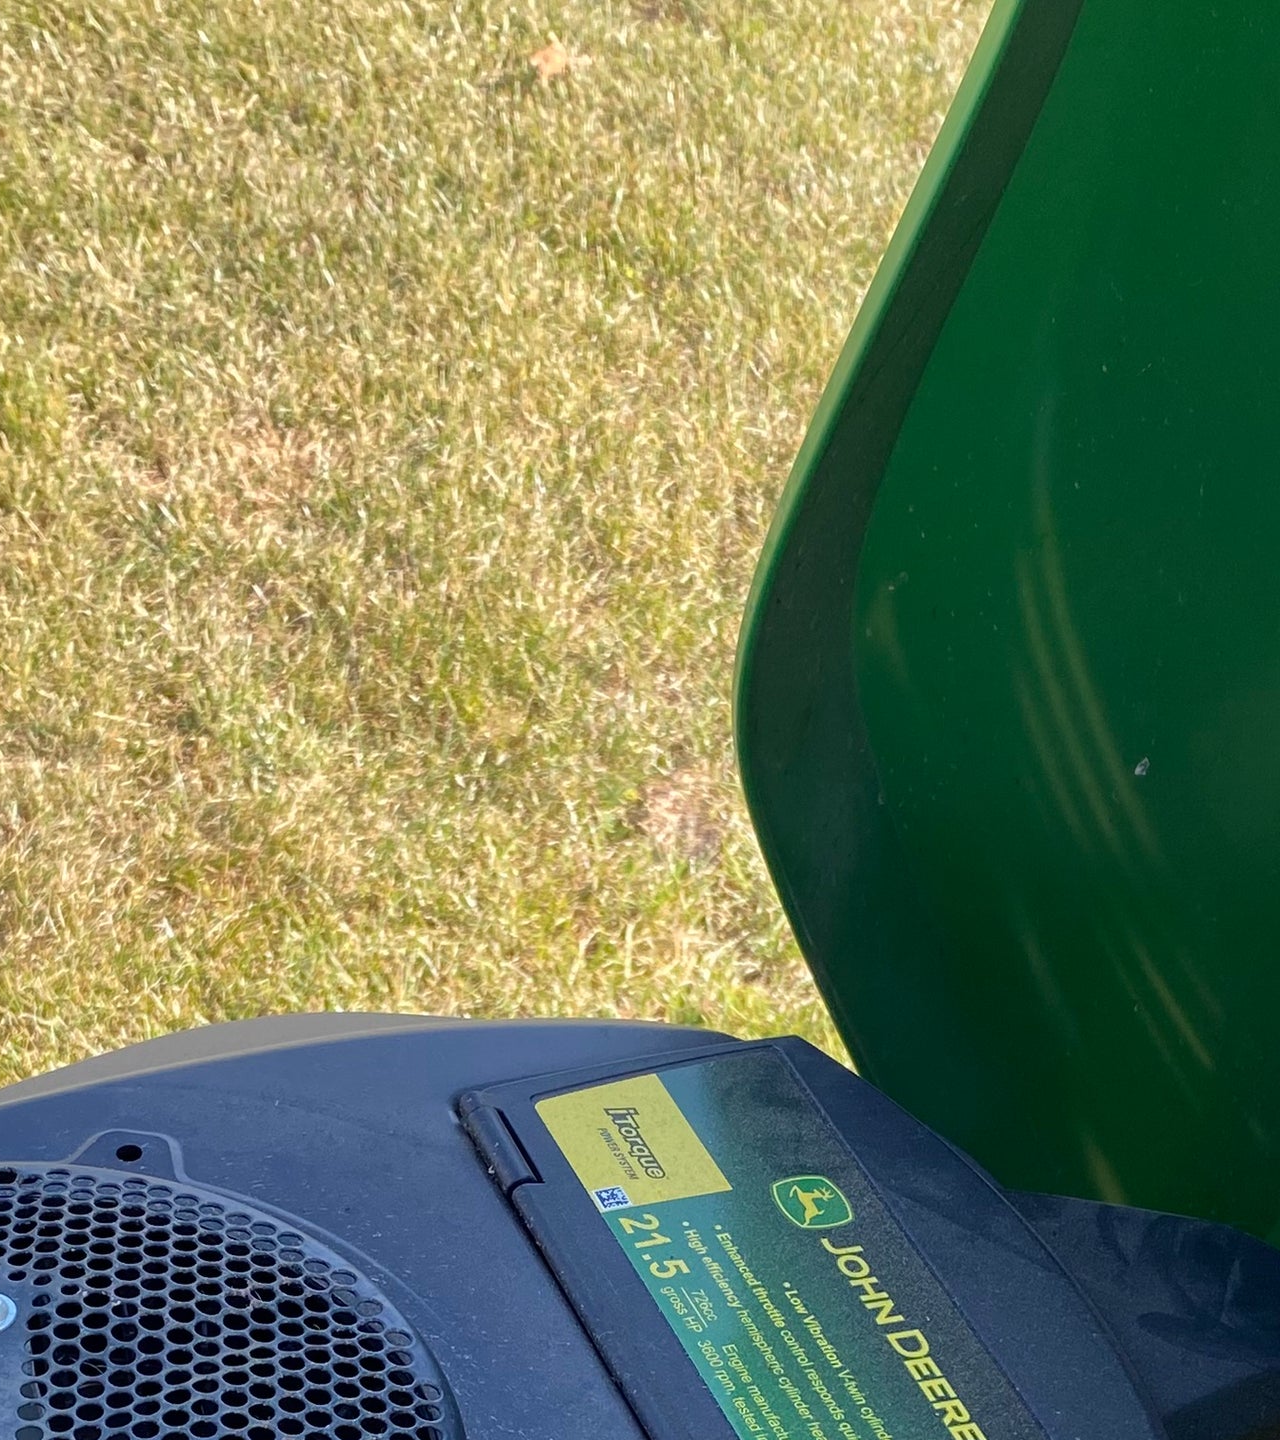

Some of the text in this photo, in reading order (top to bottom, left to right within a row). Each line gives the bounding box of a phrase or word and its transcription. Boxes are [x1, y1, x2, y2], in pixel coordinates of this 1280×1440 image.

[597, 1127, 640, 1180] POWER SYSTEM
[603, 1107, 666, 1179] iTorque
[618, 1213, 691, 1279] 21.5
[821, 1237, 905, 1325] JOHN
[660, 1286, 703, 1334] gross HP
[684, 1228, 708, 1255] High
[702, 1256, 743, 1309] efficiency
[736, 1309, 784, 1376] hemispheric
[778, 1376, 814, 1420] cylinder
[690, 1289, 718, 1322] 726cc
[716, 1232, 761, 1287] Enhanced
[752, 1285, 786, 1329] throttle
[780, 1329, 814, 1368] control
[805, 1368, 845, 1421] responds
[722, 1344, 753, 1384] Engine
[784, 1290, 809, 1315] Low
[803, 1315, 843, 1369] Vibration
[838, 1369, 866, 1405] V-twin
[697, 1339, 723, 1368] 3600
[715, 1368, 736, 1396] rpm,
[732, 1396, 763, 1432] tested
